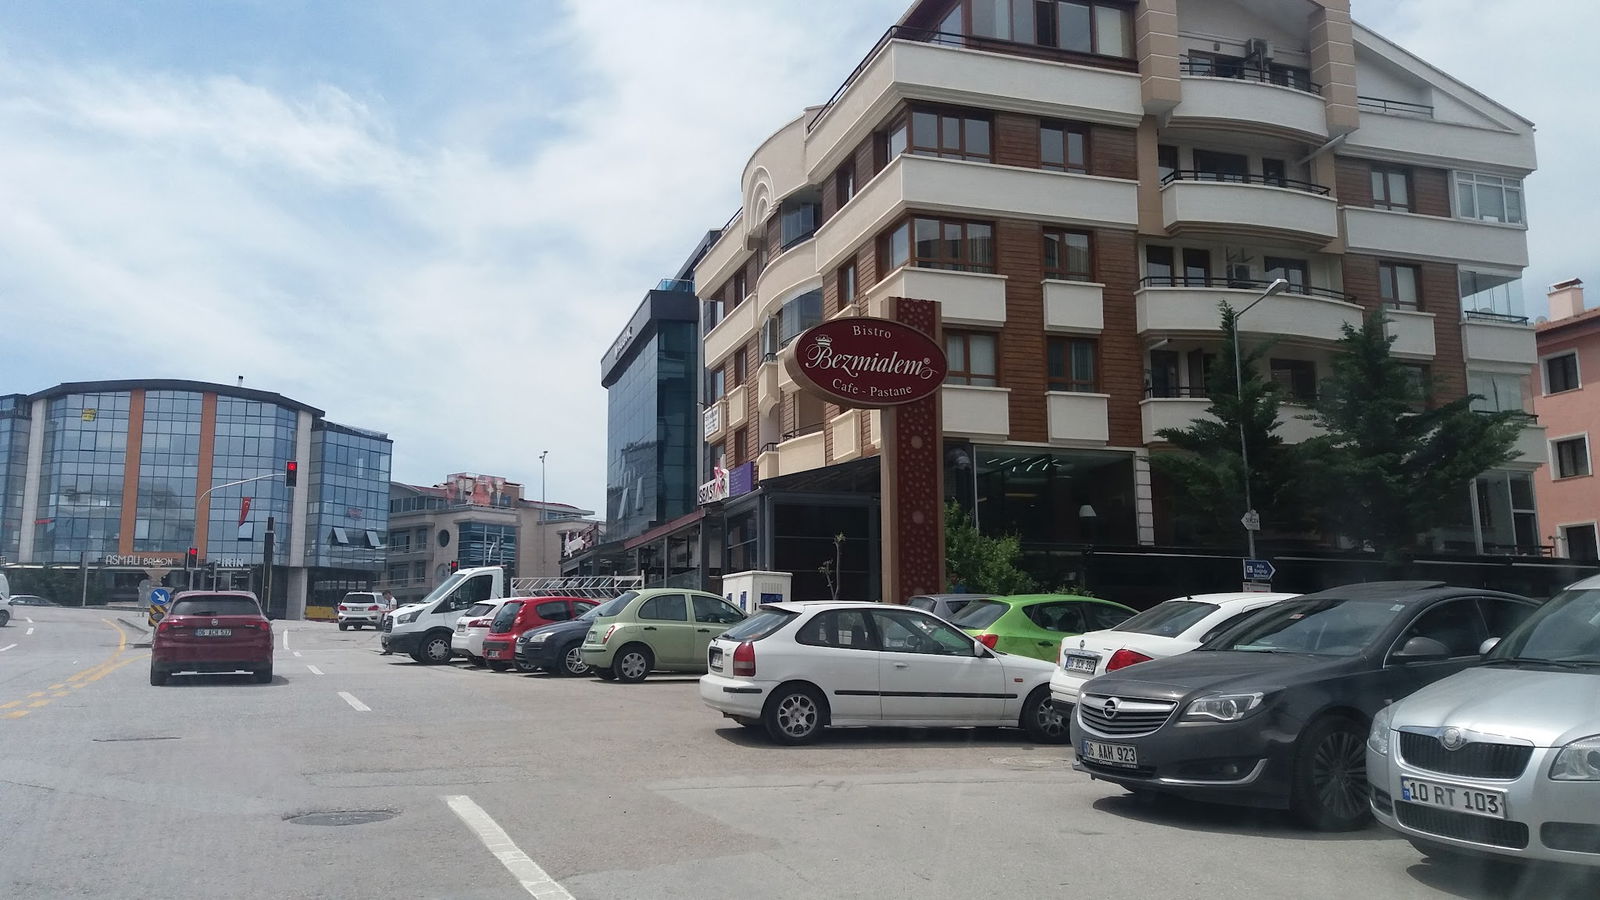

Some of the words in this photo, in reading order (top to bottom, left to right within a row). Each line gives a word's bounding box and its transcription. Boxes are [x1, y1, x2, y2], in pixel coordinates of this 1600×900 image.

[852, 325, 892, 339] Bistro
[804, 343, 939, 380] Bezmialem
[832, 378, 859, 394] Cafe
[870, 385, 912, 397] Pastane
[1098, 744, 1114, 760] AAH
[1116, 746, 1136, 762] 923
[1410, 782, 1429, 801] 10
[1434, 786, 1456, 807] RT
[1463, 791, 1499, 814] 103
